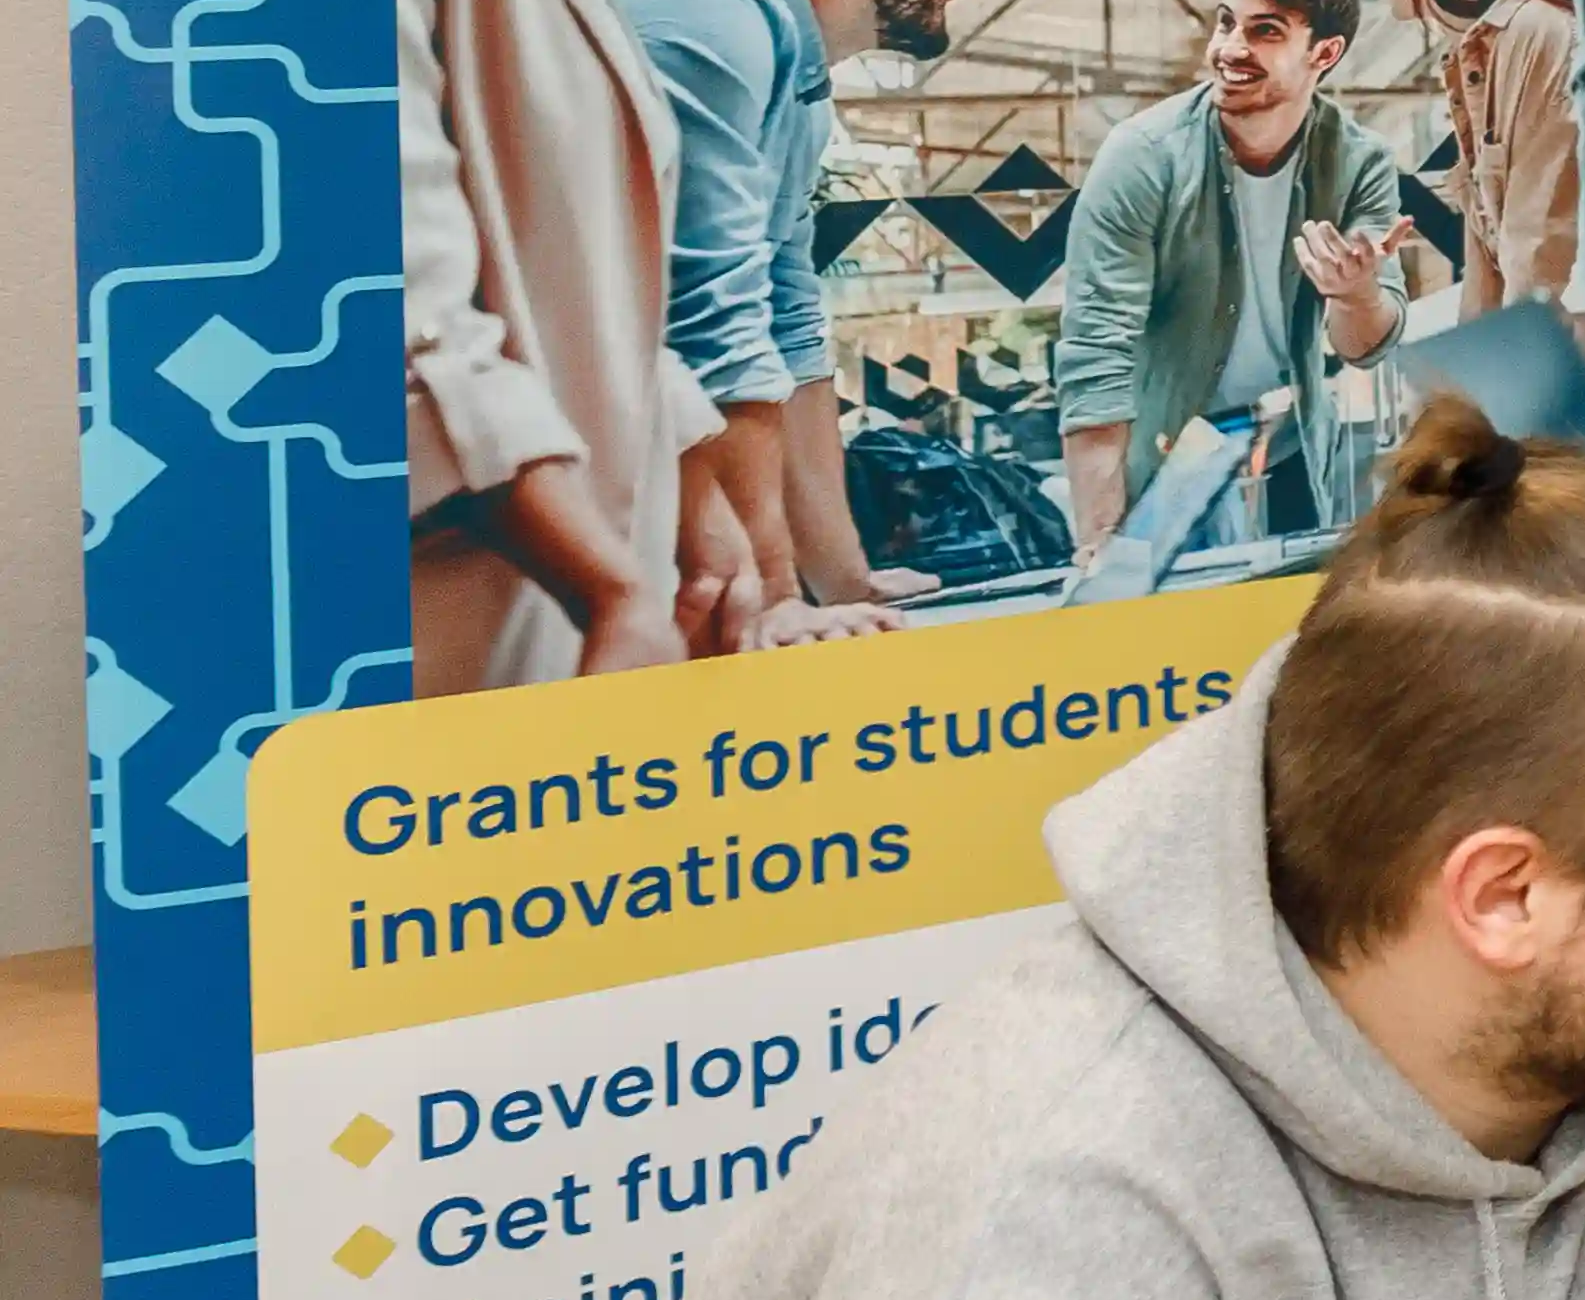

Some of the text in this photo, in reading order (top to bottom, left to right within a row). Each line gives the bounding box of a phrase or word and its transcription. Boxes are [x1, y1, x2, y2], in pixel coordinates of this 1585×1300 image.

[344, 666, 1232, 856] Grants for students
[351, 823, 910, 970] innovations
[418, 1034, 801, 1162] Develop
[418, 1174, 592, 1267] Get
